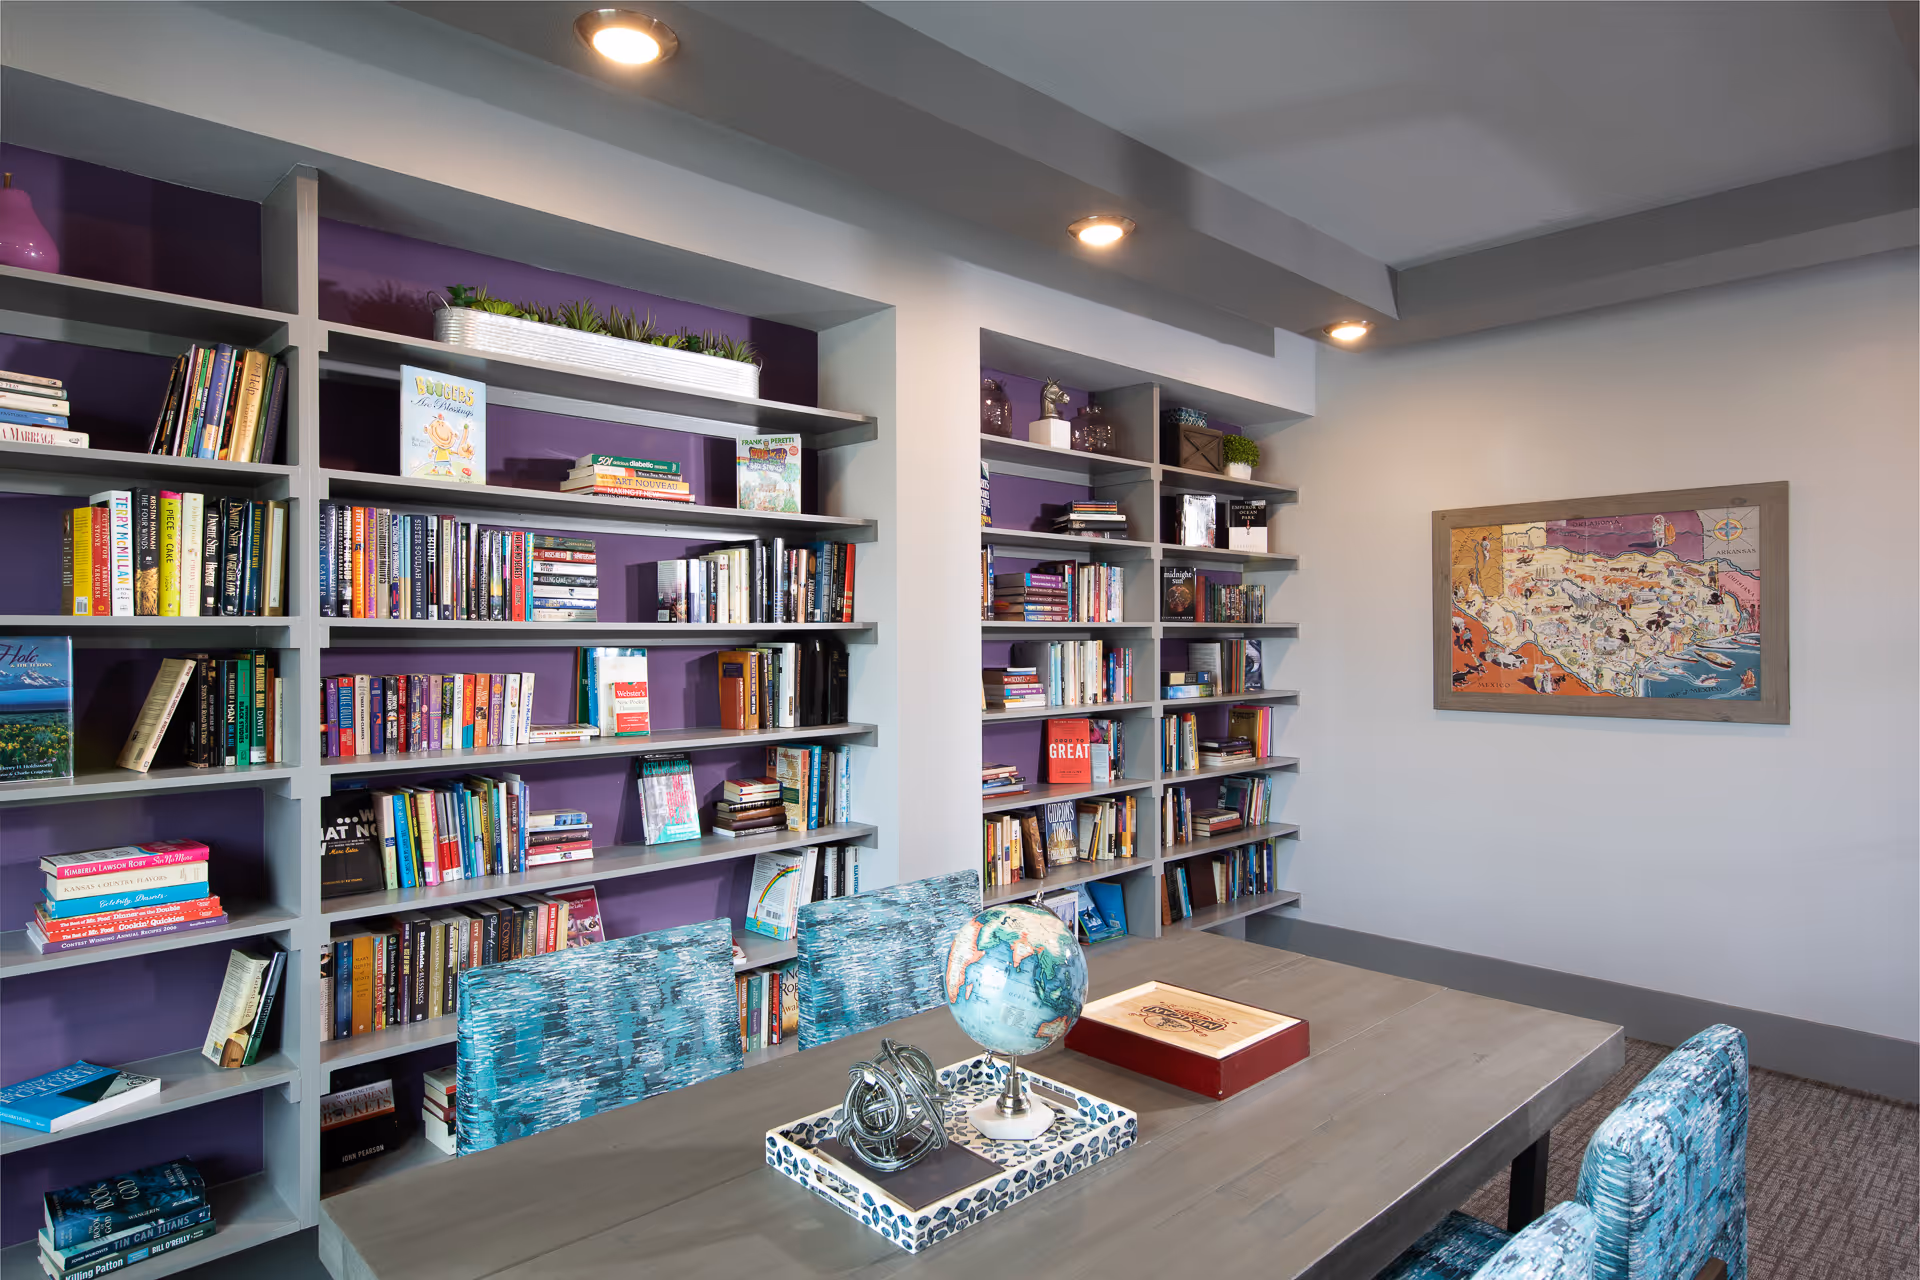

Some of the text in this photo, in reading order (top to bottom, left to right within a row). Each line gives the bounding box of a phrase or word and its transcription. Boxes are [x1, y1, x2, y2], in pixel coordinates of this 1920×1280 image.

[245, 373, 262, 396] Help
[415, 376, 474, 407] BOOGERS
[434, 398, 474, 418] Blessings
[10, 427, 56, 445] MARRIAGE
[597, 456, 654, 469] 501 diabetic
[607, 488, 635, 496] MAKING
[615, 478, 678, 490] ART NOUVEAU
[116, 497, 128, 530] TERRY
[141, 509, 149, 526] FOUR
[229, 502, 243, 529] DANIELLE
[1572, 520, 1620, 528] OKLAHOMA
[355, 509, 363, 542] THE ITCH
[414, 519, 422, 544] SISTER
[141, 528, 149, 550] WINDS
[165, 510, 174, 564] PIECE CAKE
[514, 534, 522, 545] TELL
[427, 536, 435, 563] BOND
[343, 563, 352, 580] CLUB
[413, 546, 422, 579] SOULJAH
[514, 560, 522, 579] SECRETS
[1163, 568, 1192, 580] midnight
[1725, 572, 1755, 598] LOUISIANA
[256, 654, 265, 708] THE MATURE MAN
[617, 689, 645, 697] Webster's
[228, 704, 236, 722] MAN
[340, 687, 351, 728] JACKIE COLLINS
[493, 704, 501, 740] cheaters
[1049, 743, 1090, 759] GREAT
[643, 759, 690, 776] CECIL WILLIAMS
[1048, 800, 1075, 823] GIDEON'S
[1052, 821, 1073, 842] TORCH
[64, 866, 97, 877] KIMBERLA
[98, 862, 127, 872] LAWSON
[128, 859, 147, 869] ROBY
[152, 855, 164, 866] Sin
[63, 874, 168, 894] KANSAS COUNTRY FLAVORS
[97, 915, 111, 923] Food
[112, 910, 138, 920] Dinner
[155, 905, 181, 914] Double
[88, 928, 99, 936] Mr.
[100, 926, 114, 934] Food
[118, 921, 149, 932] Cookin'
[150, 915, 185, 927] Quickies
[61, 940, 87, 949] CONTEST
[89, 935, 115, 944] WINNING
[116, 931, 140, 940] ANNUAL
[141, 927, 163, 936] RECIPES
[245, 1001, 255, 1018] child
[253, 995, 274, 1039] Transitioning
[1148, 1007, 1217, 1030] MEXICAN
[342, 1144, 385, 1163] JOHN PEARSON
[128, 1207, 161, 1220] WANGERIN
[71, 1255, 84, 1264] JOHN
[85, 1247, 109, 1260] WUKOVITS
[114, 1236, 130, 1250] TIN
[133, 1230, 154, 1244] CAN
[157, 1216, 191, 1236] TITANS
[95, 1234, 191, 1276] Patton BILL O'REILLY
